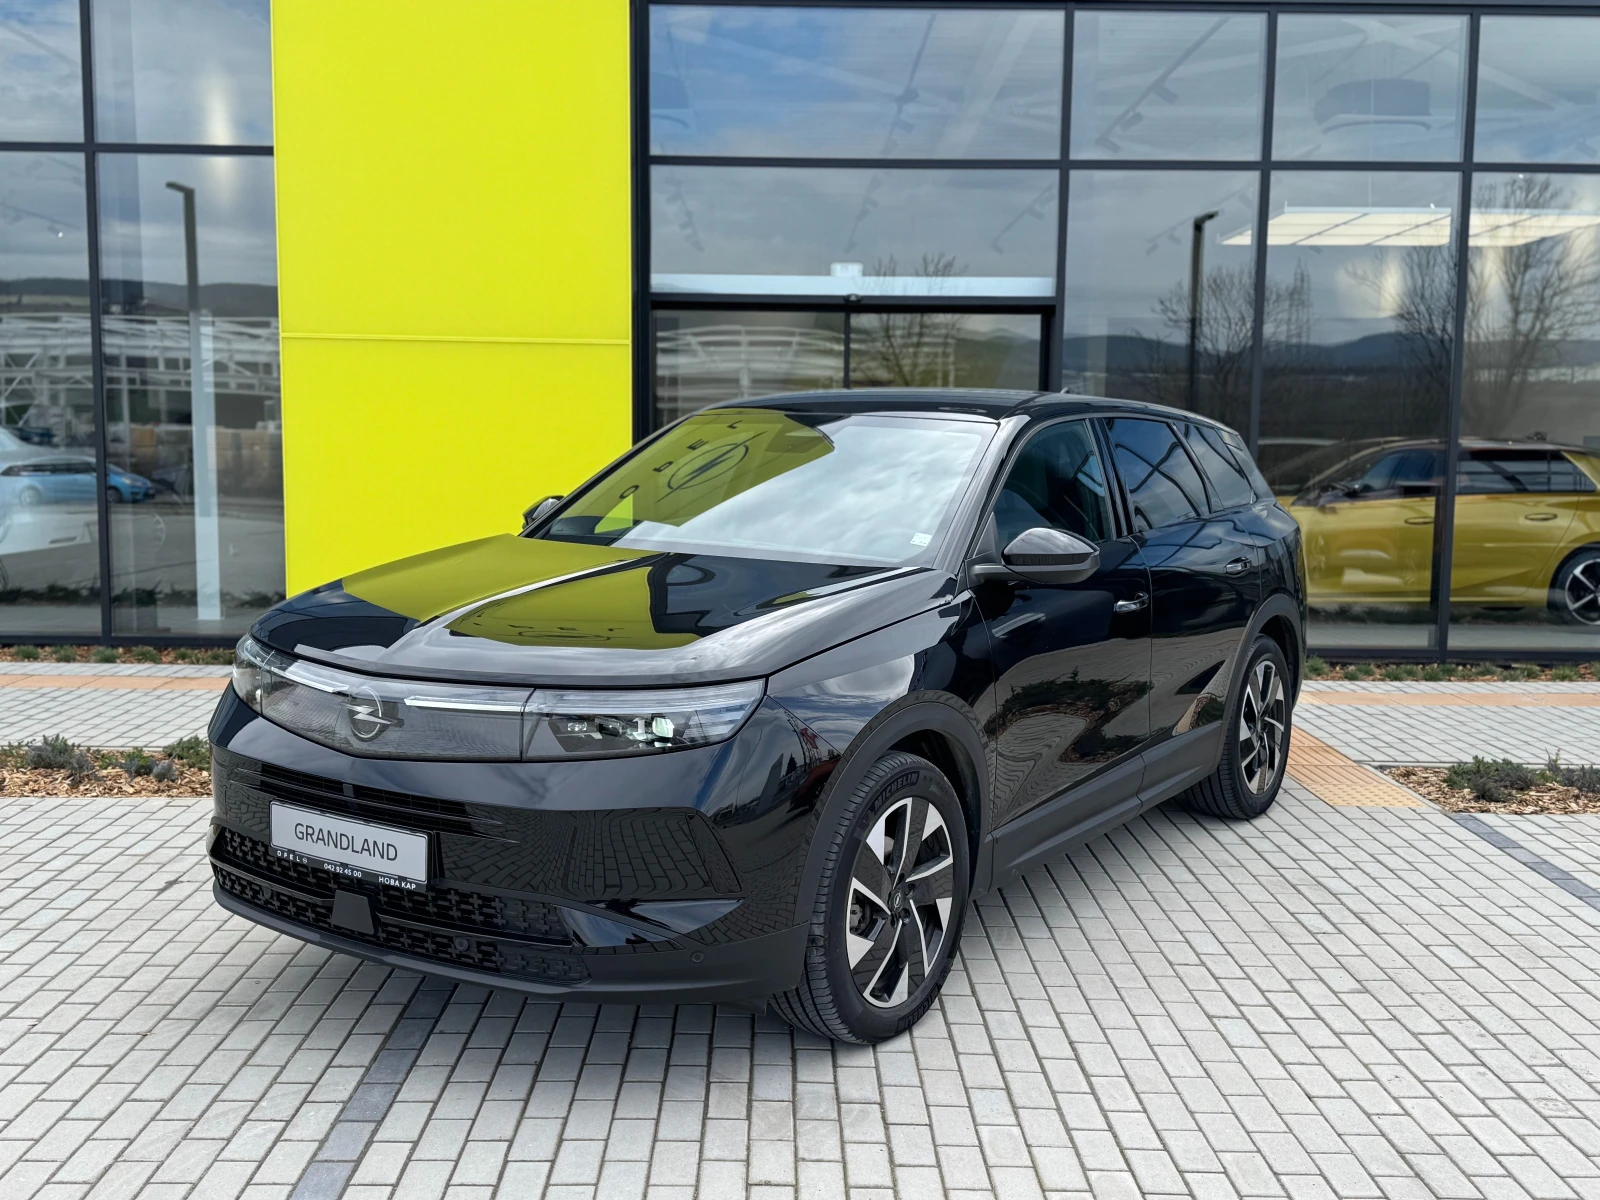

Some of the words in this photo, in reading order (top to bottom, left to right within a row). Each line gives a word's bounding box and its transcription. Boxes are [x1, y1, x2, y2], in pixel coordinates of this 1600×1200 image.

[874, 772, 919, 812] MICHELIN
[294, 822, 398, 861] GRANDLAND
[277, 850, 301, 862] OPEL
[323, 862, 335, 872] 042
[336, 865, 344, 873] 92
[344, 868, 352, 876] 45
[353, 870, 362, 878] 00
